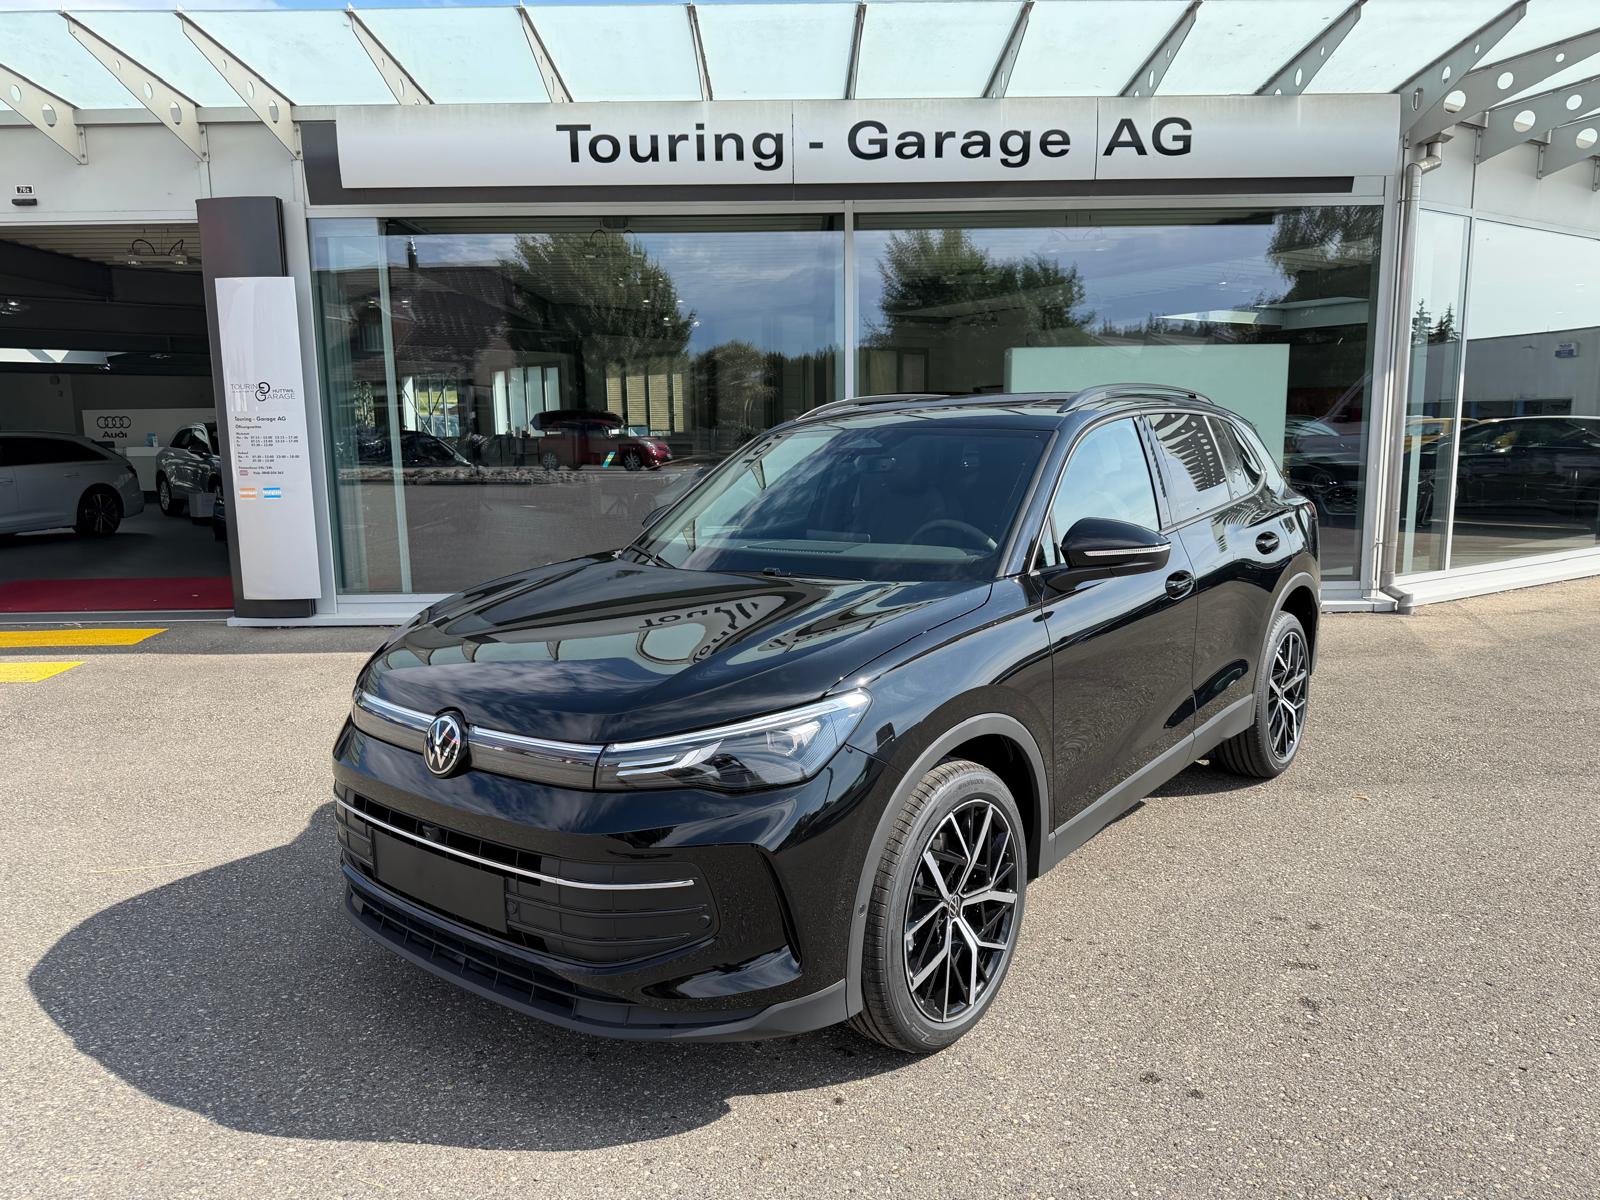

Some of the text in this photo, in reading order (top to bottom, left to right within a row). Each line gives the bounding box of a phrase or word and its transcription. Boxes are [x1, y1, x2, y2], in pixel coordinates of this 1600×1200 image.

[555, 117, 1193, 171] Touring - Garage AG
[102, 430, 128, 438] Audi
